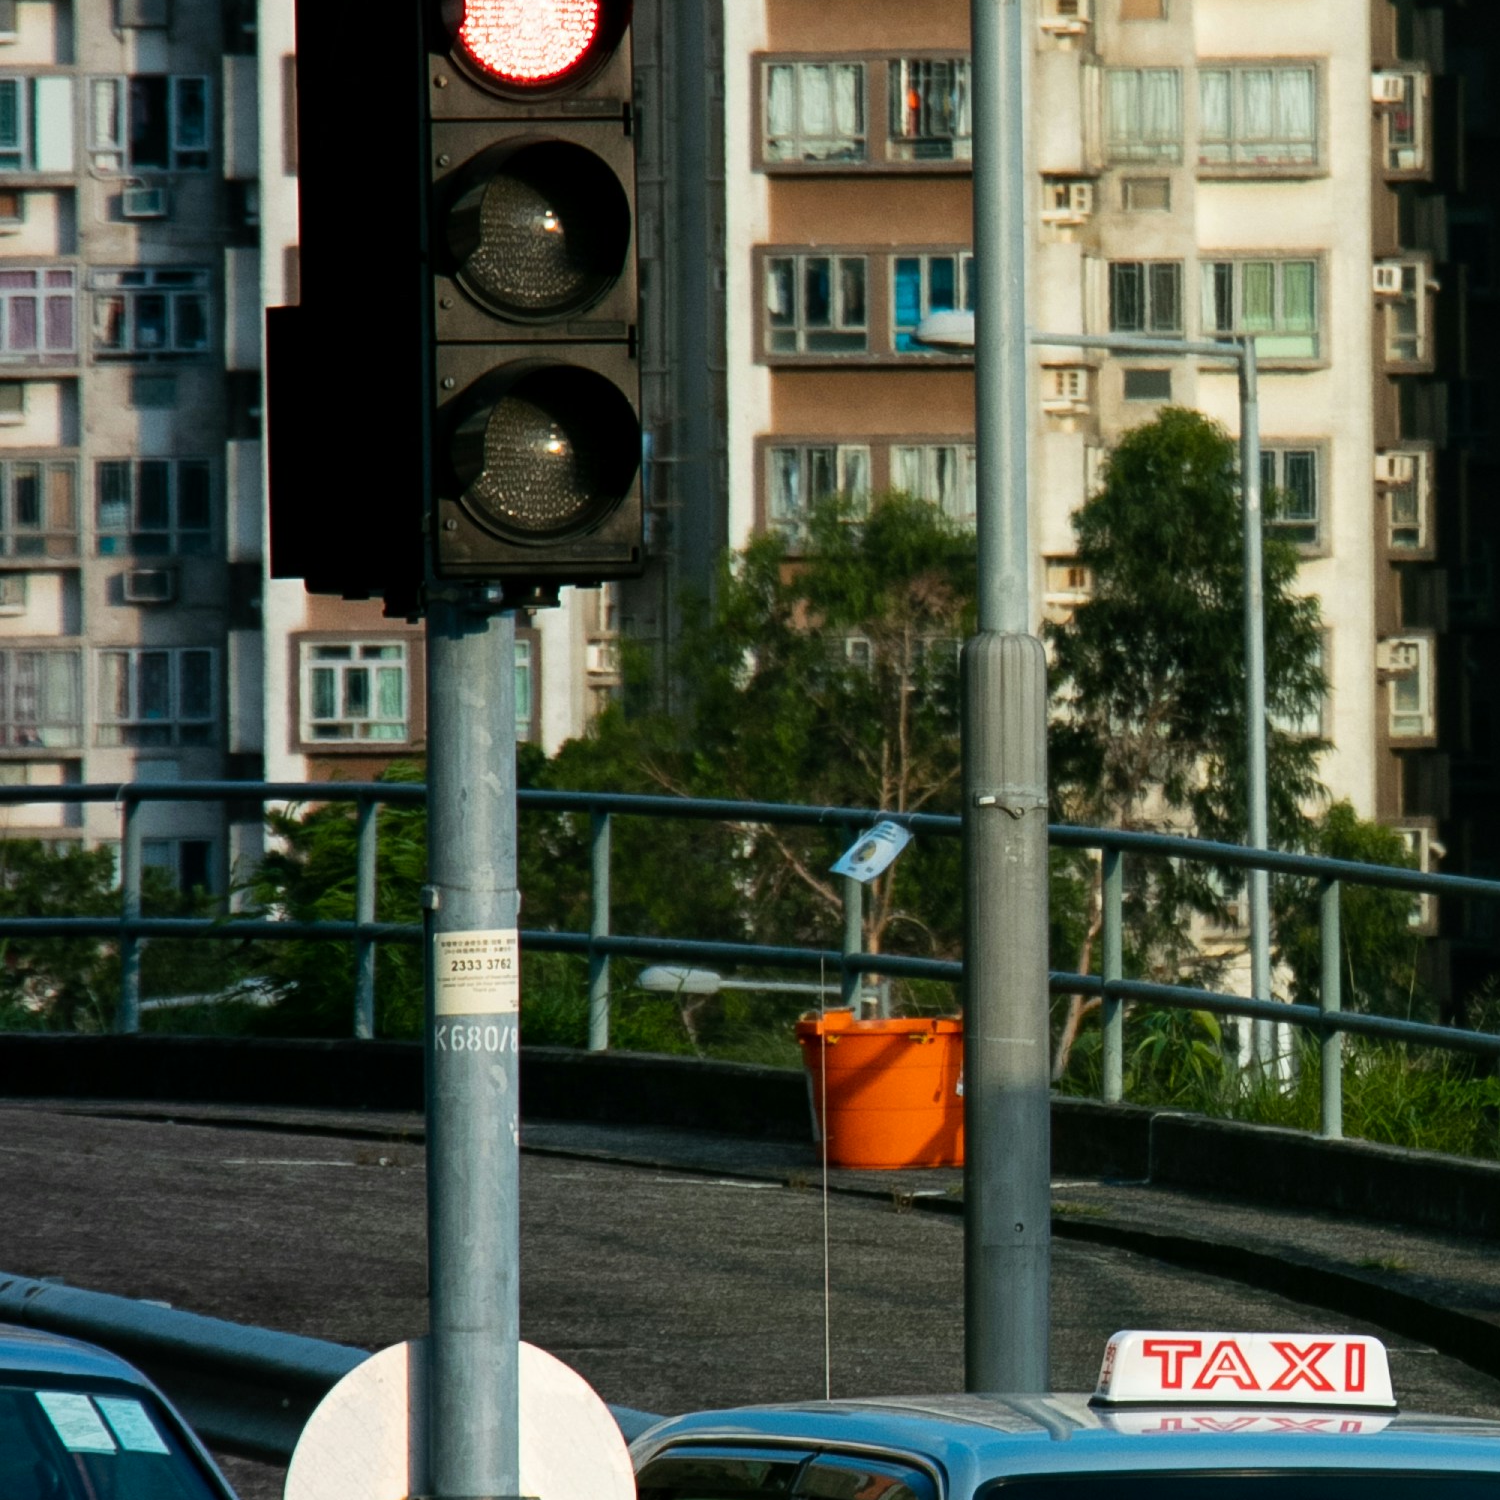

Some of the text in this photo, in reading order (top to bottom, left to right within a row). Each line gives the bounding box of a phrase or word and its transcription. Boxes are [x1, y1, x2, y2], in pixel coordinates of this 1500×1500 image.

[451, 958, 512, 972] 2333 3762
[1142, 1340, 1366, 1392] TAXI
